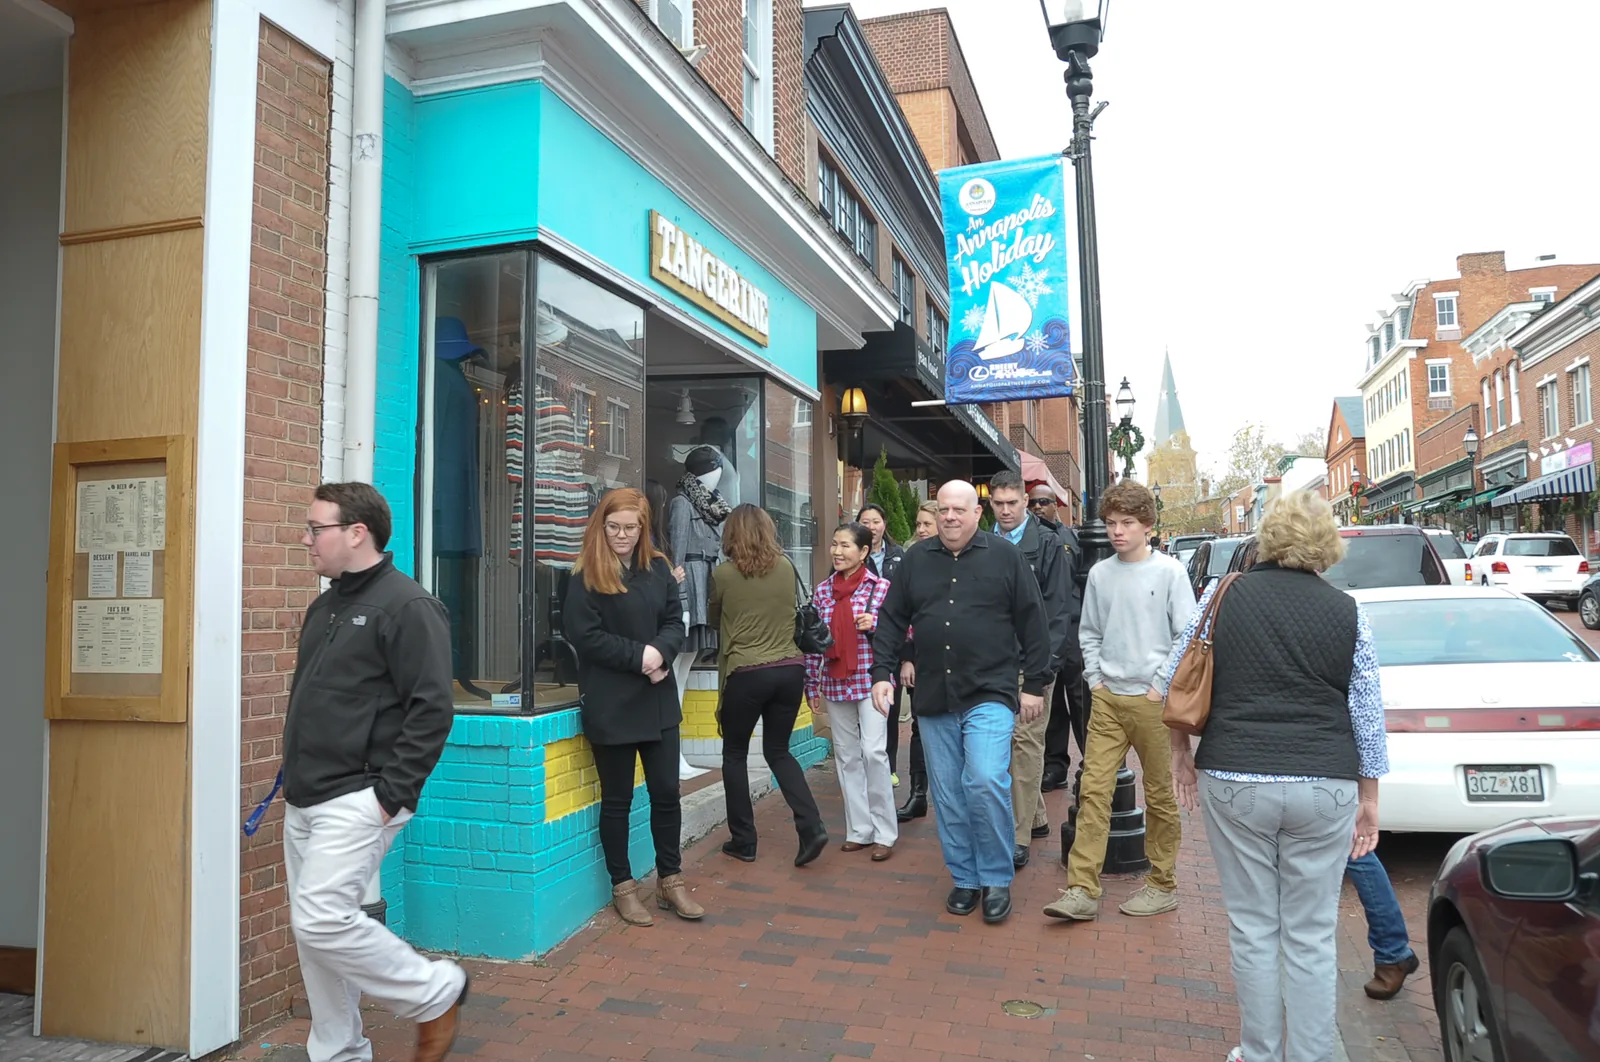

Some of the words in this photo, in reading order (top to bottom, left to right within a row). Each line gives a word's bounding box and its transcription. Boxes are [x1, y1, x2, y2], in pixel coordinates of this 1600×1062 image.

[954, 193, 1056, 261] Annapolis
[966, 216, 984, 234] An
[657, 214, 768, 337] TANGERINE
[961, 227, 1056, 297] Holiday
[93, 553, 114, 561] DESSERT
[1470, 776, 1499, 793] 3CZ
[1509, 776, 1537, 793] X81
